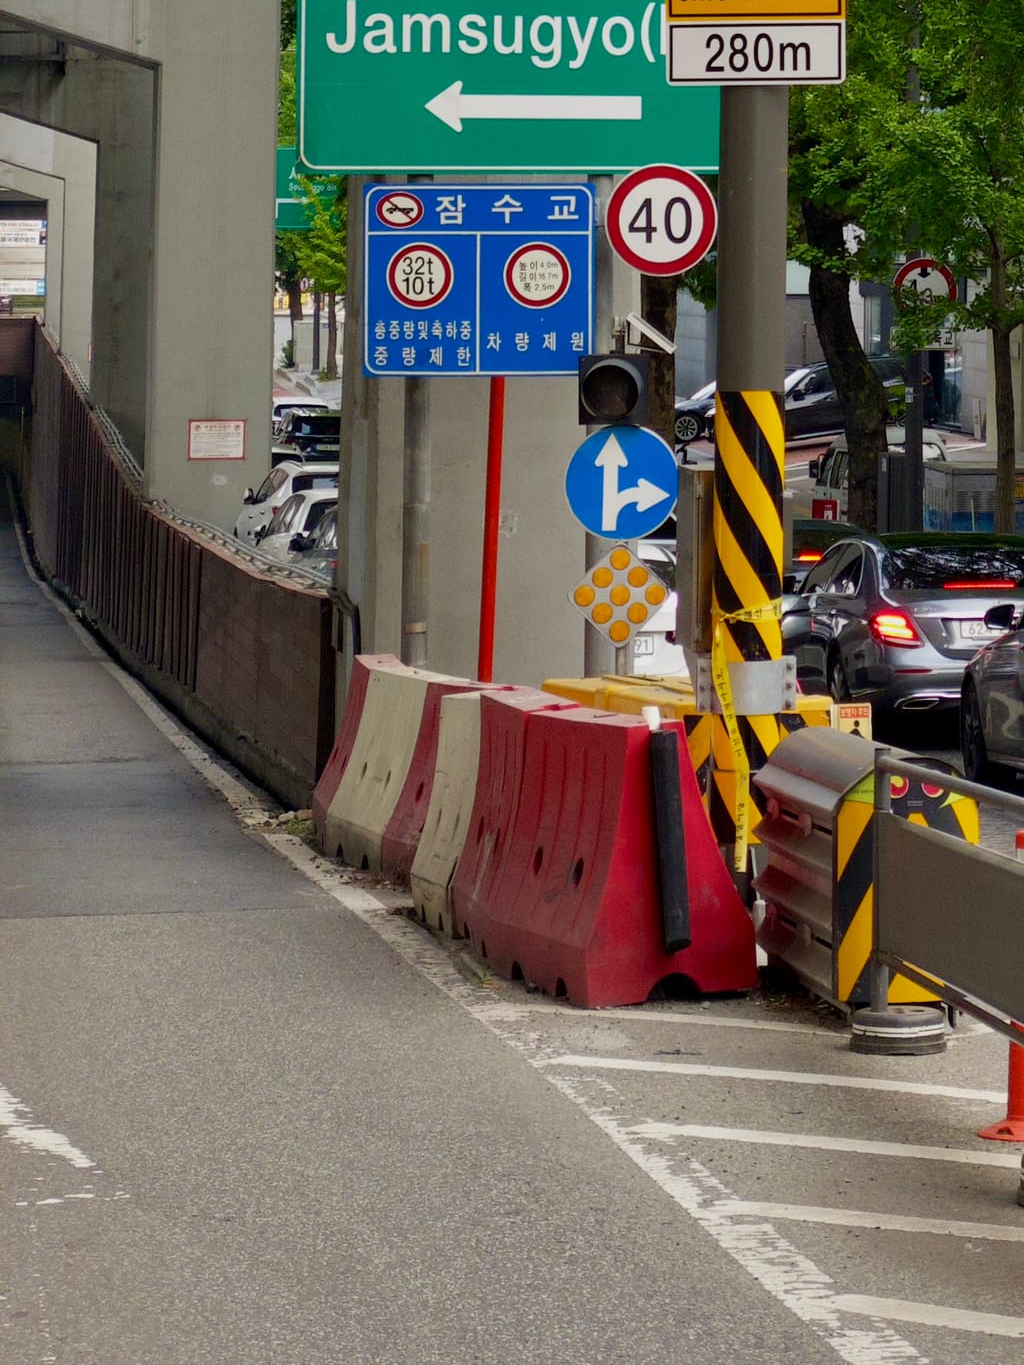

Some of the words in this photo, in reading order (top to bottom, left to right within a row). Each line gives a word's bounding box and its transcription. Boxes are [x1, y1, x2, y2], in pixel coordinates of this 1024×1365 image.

[705, 32, 812, 73] 280m
[627, 197, 693, 244] 40
[402, 256, 434, 275] 32t
